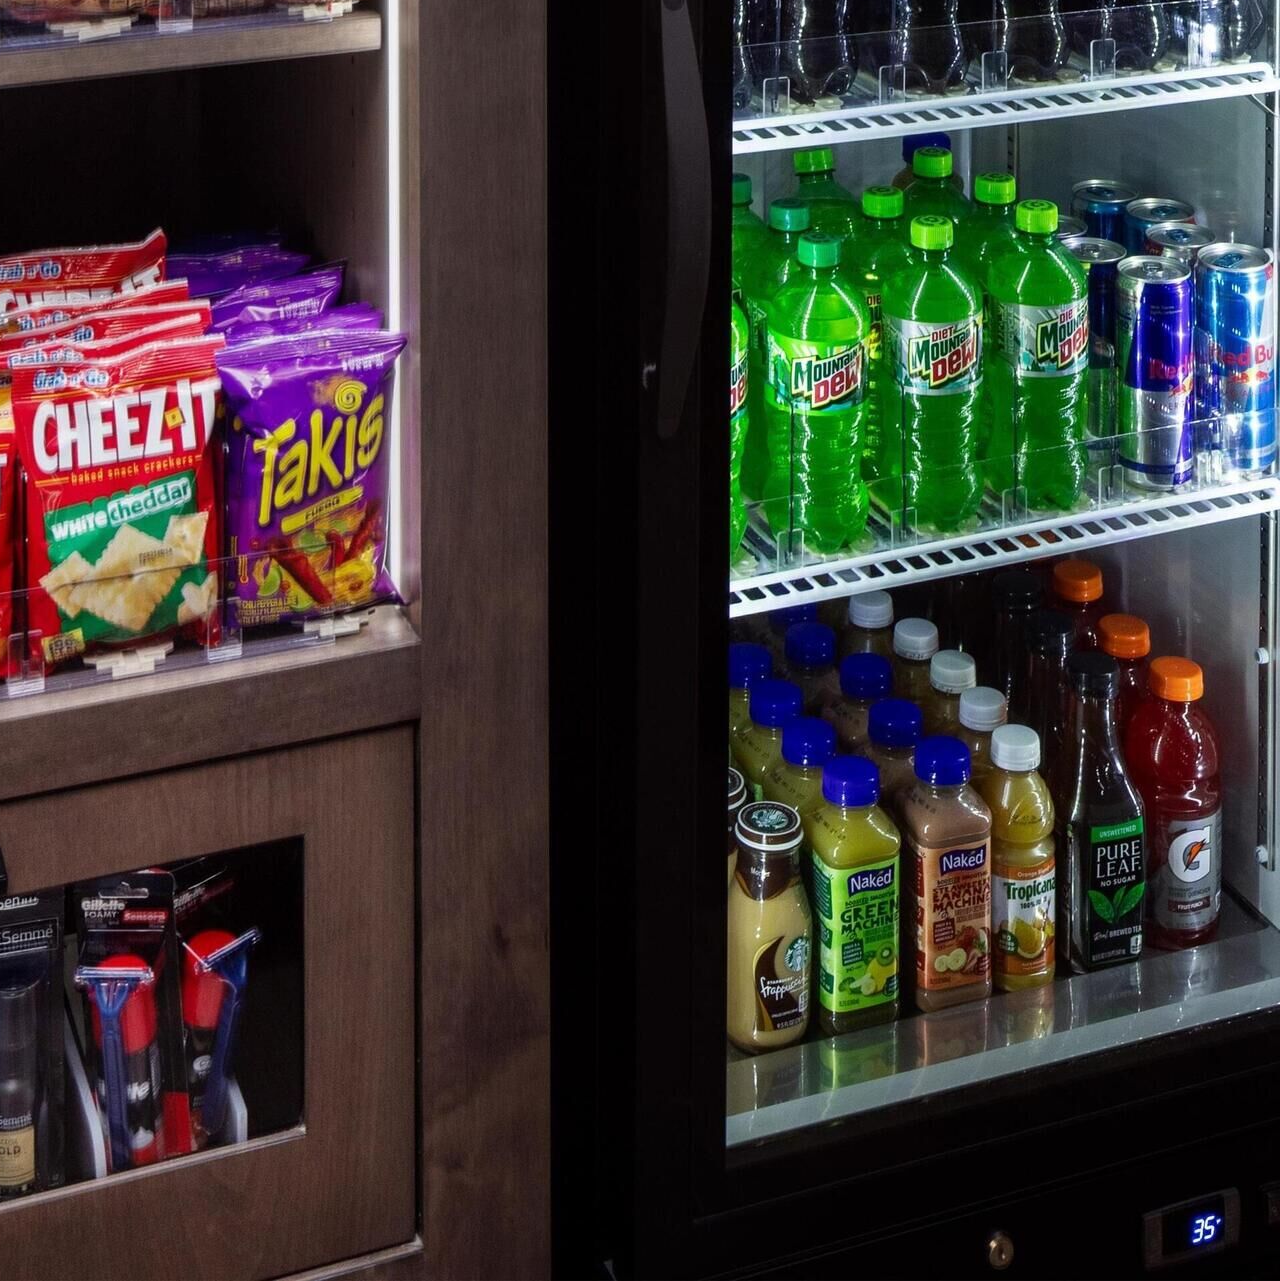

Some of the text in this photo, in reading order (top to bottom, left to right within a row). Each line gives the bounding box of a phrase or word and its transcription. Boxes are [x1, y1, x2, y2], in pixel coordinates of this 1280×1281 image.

[41, 260, 61, 279] Go
[253, 382, 384, 527] Takis
[70, 454, 194, 486] baked snack crackers
[110, 478, 191, 523] cheddar
[1099, 824, 1137, 838] UNSWEETENED
[1096, 839, 1141, 863] PURE
[1168, 826, 1211, 883] G
[1003, 877, 1056, 901] Tropicana
[1100, 874, 1136, 887] NO SUGAR
[81, 899, 125, 911] Gillette
[84, 910, 119, 919] FOAMY
[840, 896, 899, 924] GREEN
[841, 911, 900, 936] MACHINE
[1109, 924, 1142, 938] BREWED TEA
